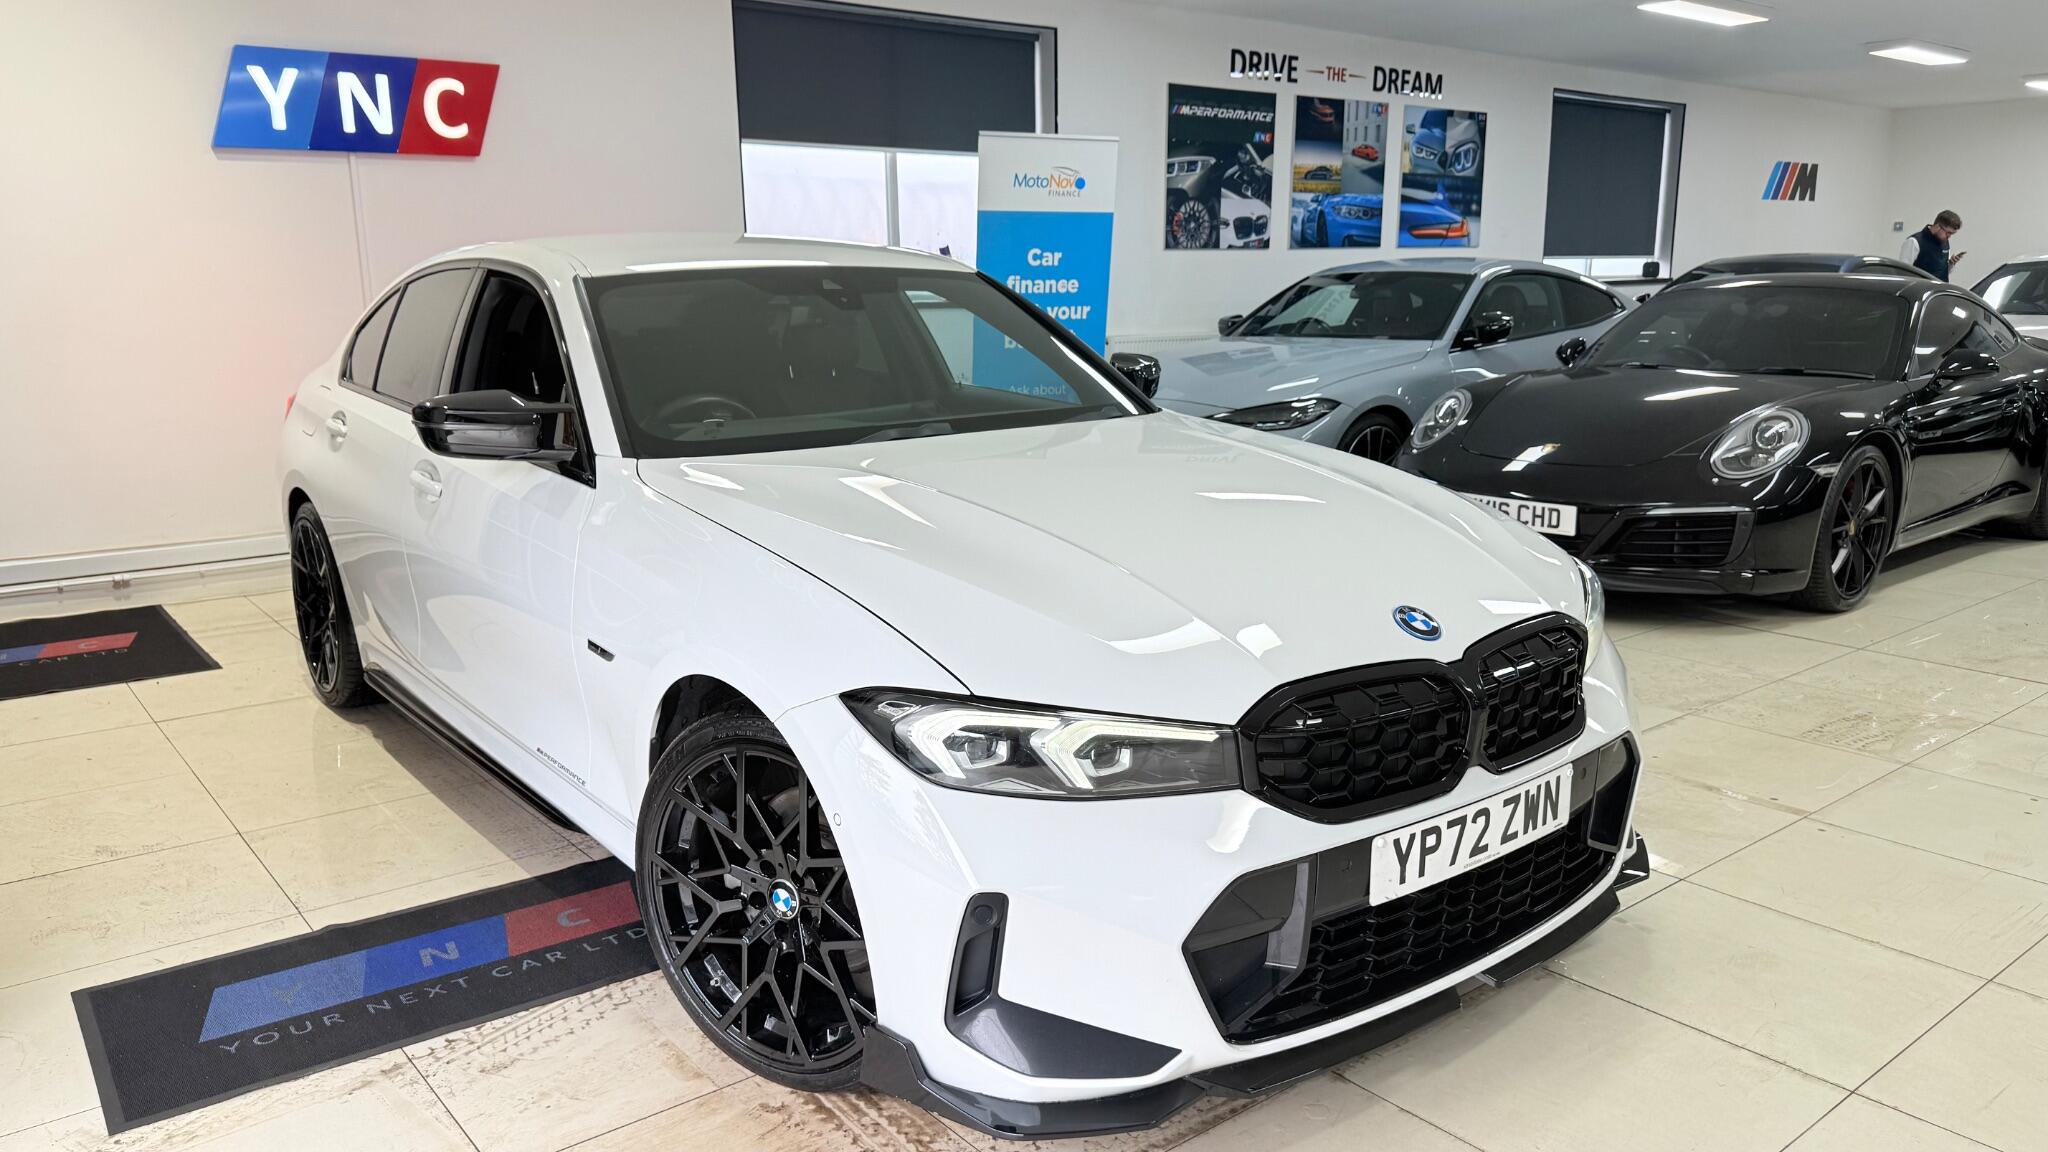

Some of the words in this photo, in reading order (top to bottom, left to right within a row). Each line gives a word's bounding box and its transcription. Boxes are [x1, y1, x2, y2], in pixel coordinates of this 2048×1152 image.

[1230, 48, 1299, 83] DRIVE
[1325, 66, 1347, 82] THE
[1372, 66, 1443, 99] DREAM
[246, 65, 469, 139] YNC
[1048, 190, 1081, 198] FINANCE
[1027, 248, 1062, 267] Car
[1007, 276, 1079, 294] finance
[1046, 305, 1091, 320] your
[1033, 384, 1066, 396] about
[1516, 505, 1561, 529] CHD
[1392, 806, 1491, 886] YP72
[1499, 774, 1561, 846] ZWN
[218, 1012, 346, 1054] YOUR
[366, 975, 469, 1015] NEXT
[490, 950, 567, 977] CAR
[582, 926, 648, 952] LTD
